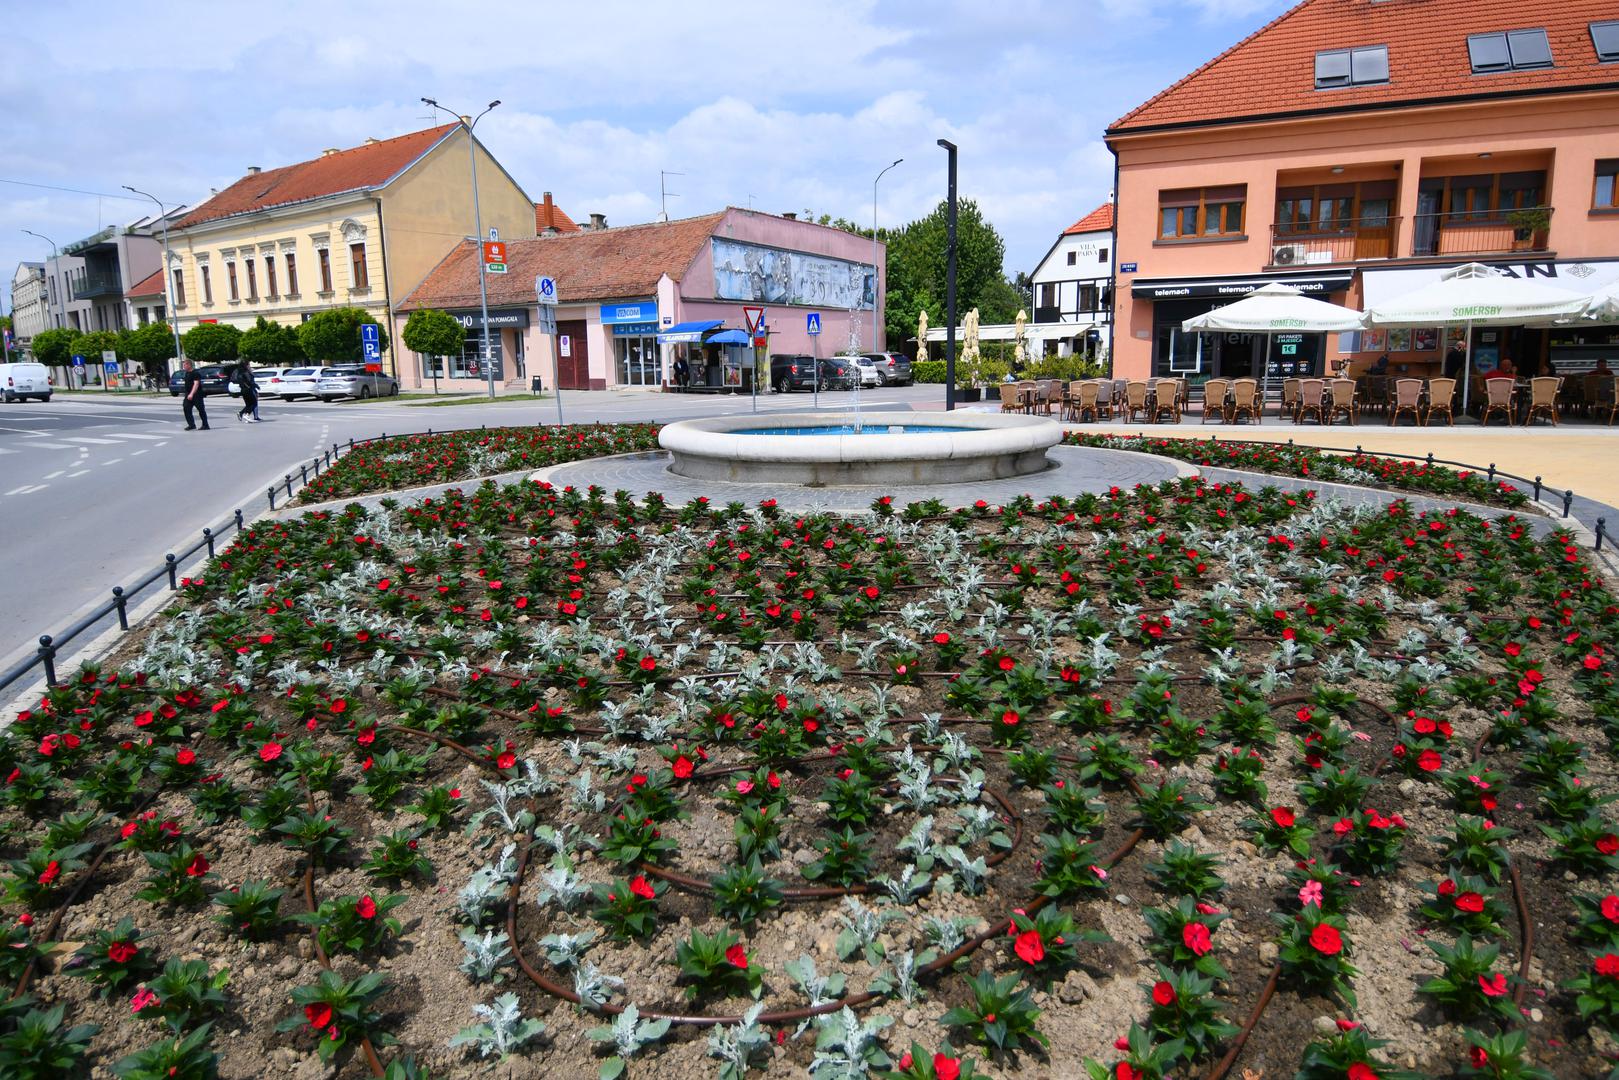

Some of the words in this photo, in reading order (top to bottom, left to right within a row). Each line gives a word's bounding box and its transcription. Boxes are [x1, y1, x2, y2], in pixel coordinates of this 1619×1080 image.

[1154, 288, 1190, 296] telemach
[1219, 285, 1255, 293] telemach
[1452, 305, 1502, 317] SOMERSBY
[1269, 319, 1308, 327] SOMERSBY
